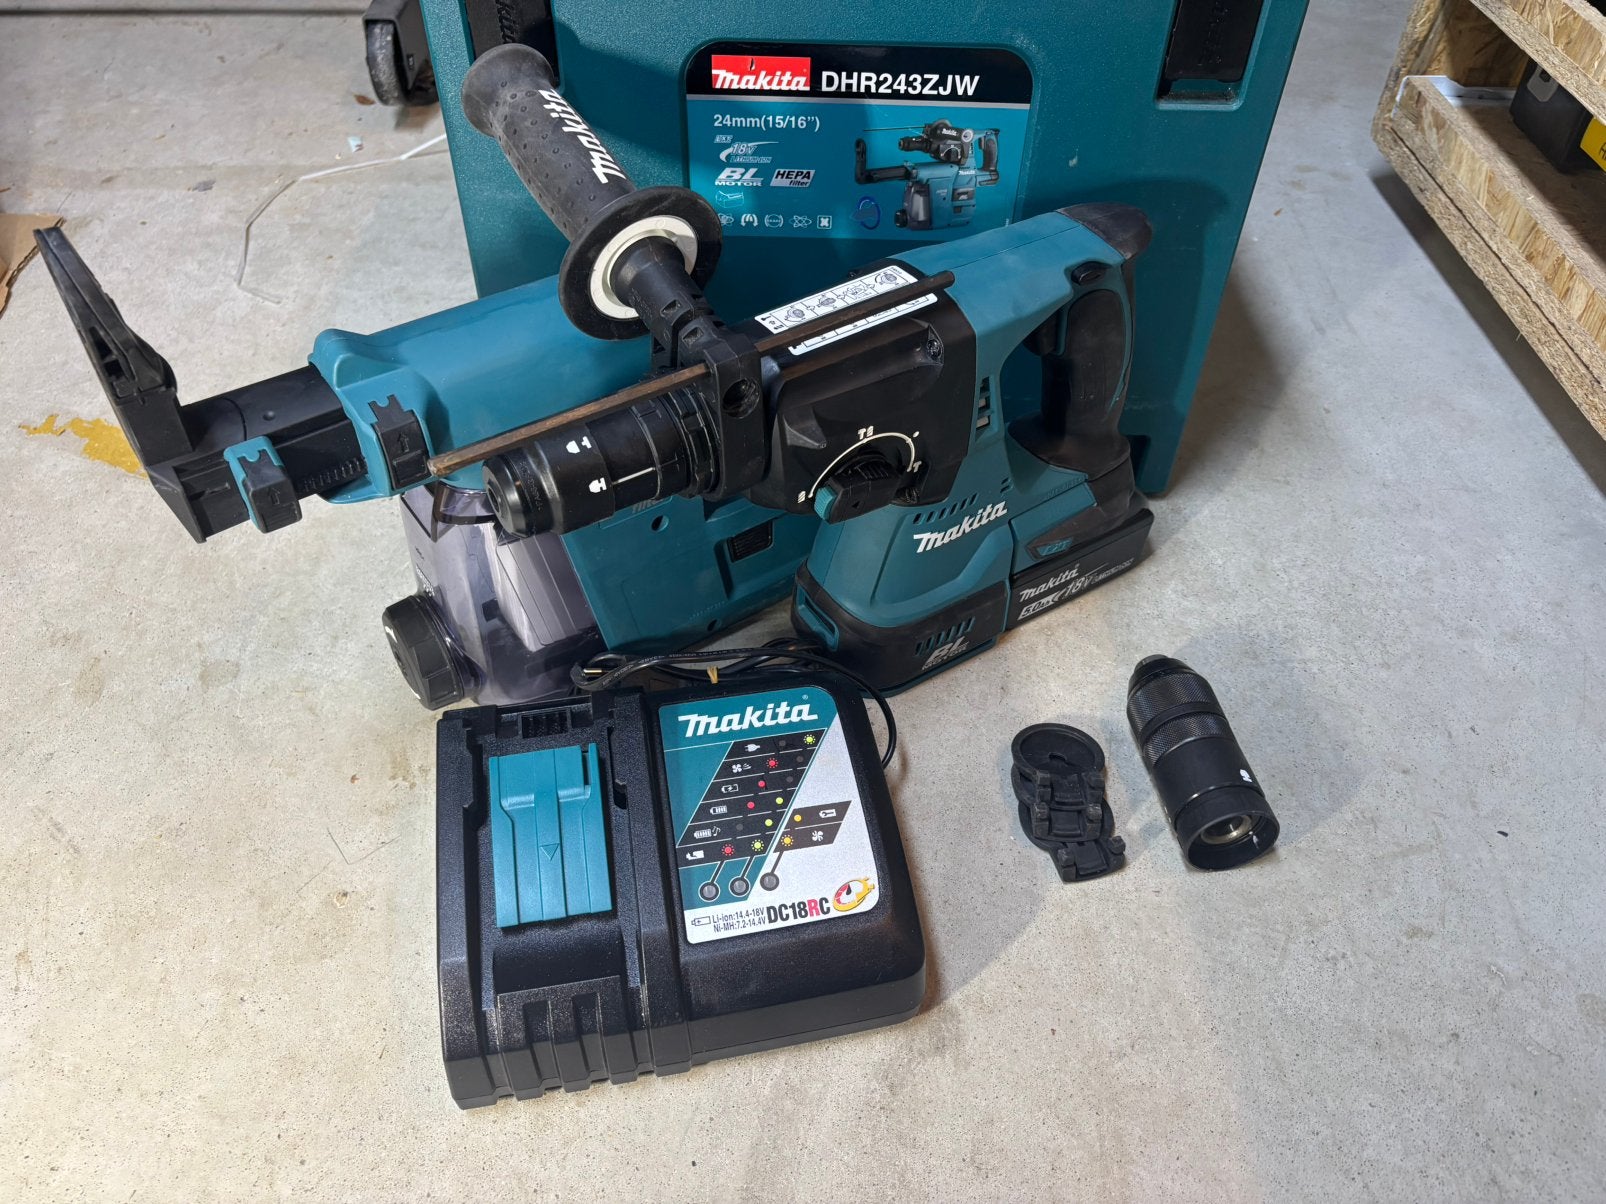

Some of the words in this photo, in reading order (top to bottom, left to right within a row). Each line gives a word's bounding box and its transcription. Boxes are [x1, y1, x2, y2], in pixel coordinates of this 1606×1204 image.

[821, 71, 979, 96] DHR243ZJW
[715, 167, 764, 182] BL
[774, 170, 811, 180] HEPA
[788, 179, 809, 187] filter
[711, 907, 765, 924] Li-ion:14.4-18V
[766, 897, 831, 924] DC18RC
[713, 915, 767, 933] Ni-MH:7.2-14.4V
